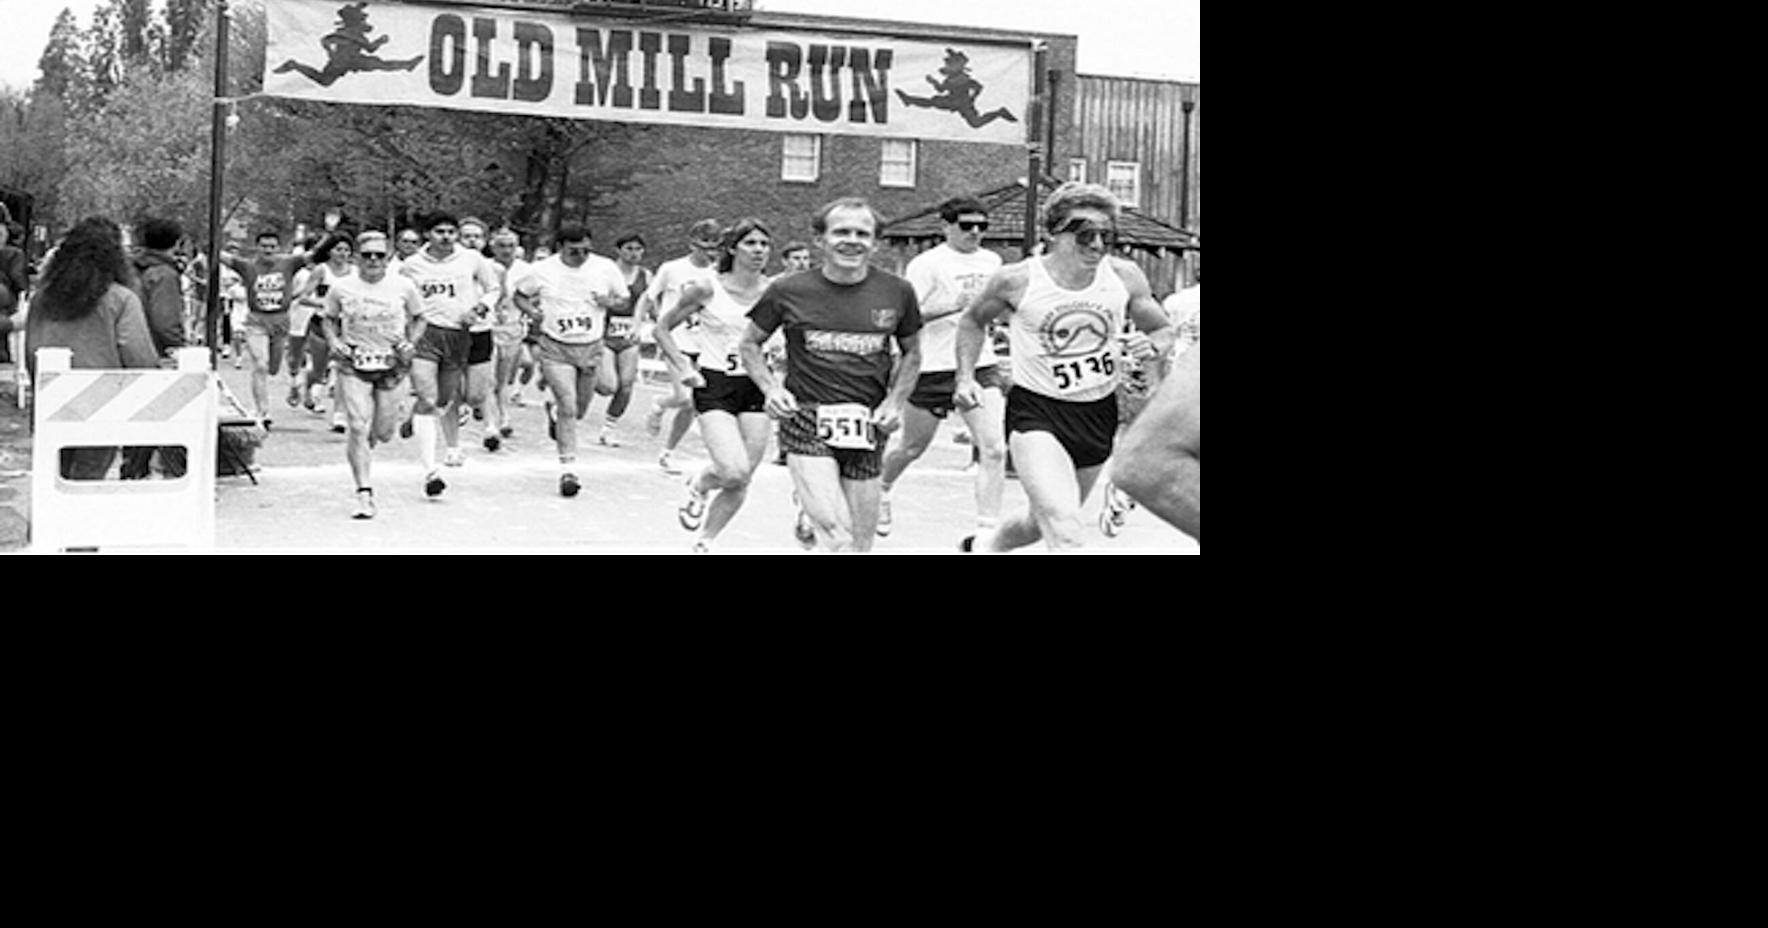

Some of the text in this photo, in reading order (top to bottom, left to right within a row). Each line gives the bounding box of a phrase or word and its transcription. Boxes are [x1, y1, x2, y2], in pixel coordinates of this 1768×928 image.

[428, 13, 894, 125] OLD MILL RUN
